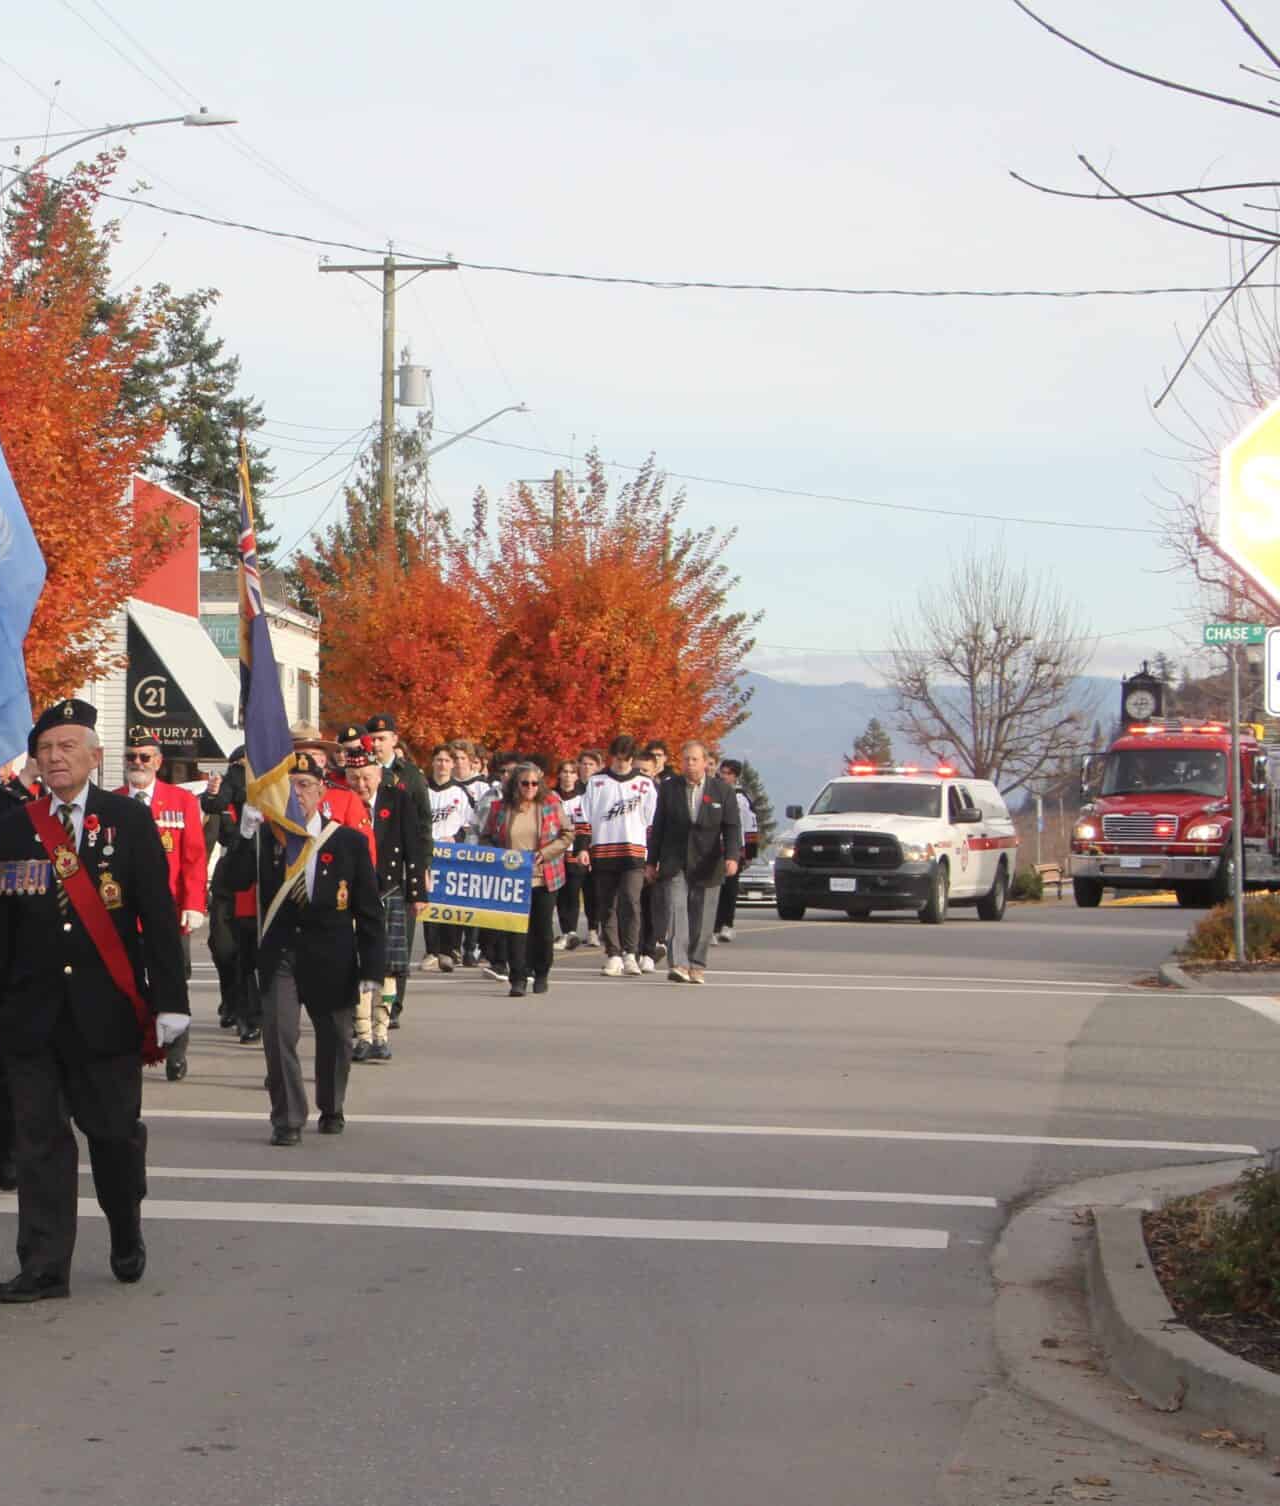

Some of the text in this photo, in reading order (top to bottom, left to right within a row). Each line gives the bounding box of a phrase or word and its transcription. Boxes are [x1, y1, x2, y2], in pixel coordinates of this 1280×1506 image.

[1205, 627, 1249, 640] CHASE
[145, 687, 166, 706] 21
[129, 727, 203, 738] CTURY 21
[456, 849, 496, 863] CLUB
[445, 871, 524, 903] SERVICE
[429, 906, 474, 922] 2017
